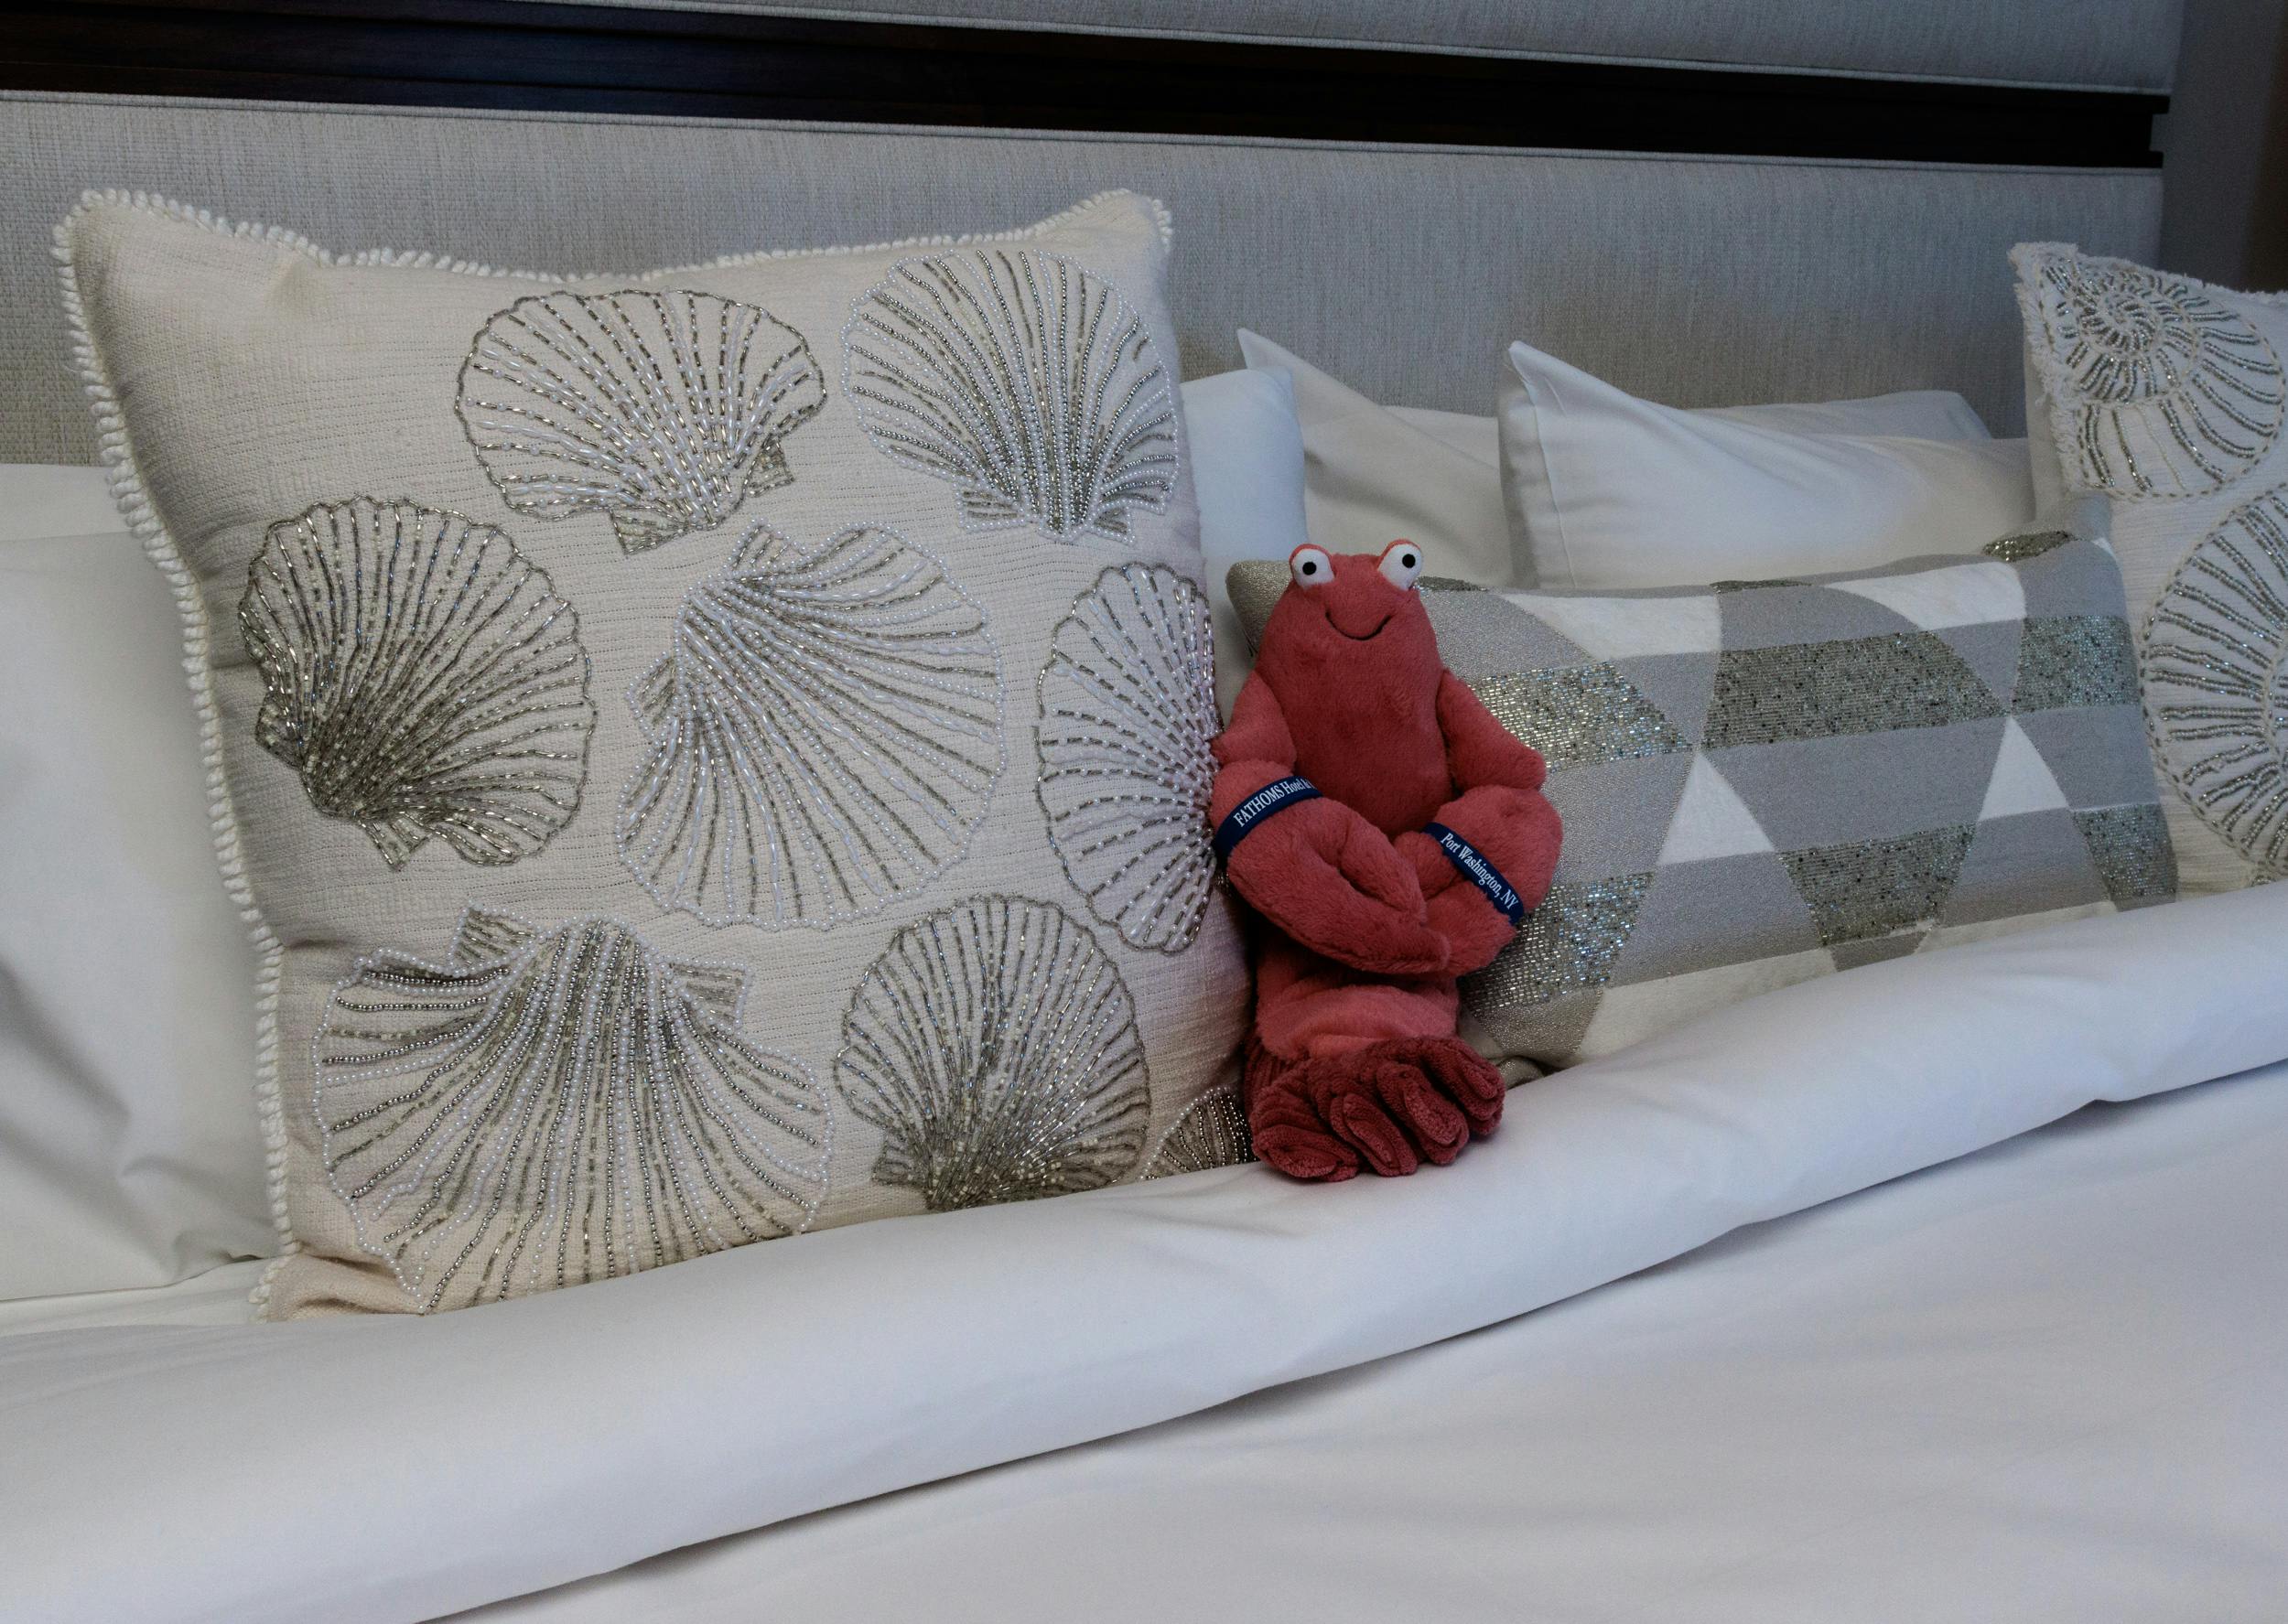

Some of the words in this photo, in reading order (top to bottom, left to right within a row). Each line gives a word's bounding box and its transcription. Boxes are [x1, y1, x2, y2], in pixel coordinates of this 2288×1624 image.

[1233, 785, 1285, 827] FATHOMS
[1279, 778, 1306, 794] Hotel
[1441, 833, 1462, 853] Port
[1458, 845, 1502, 898] Washington,
[1500, 888, 1519, 909] NY
